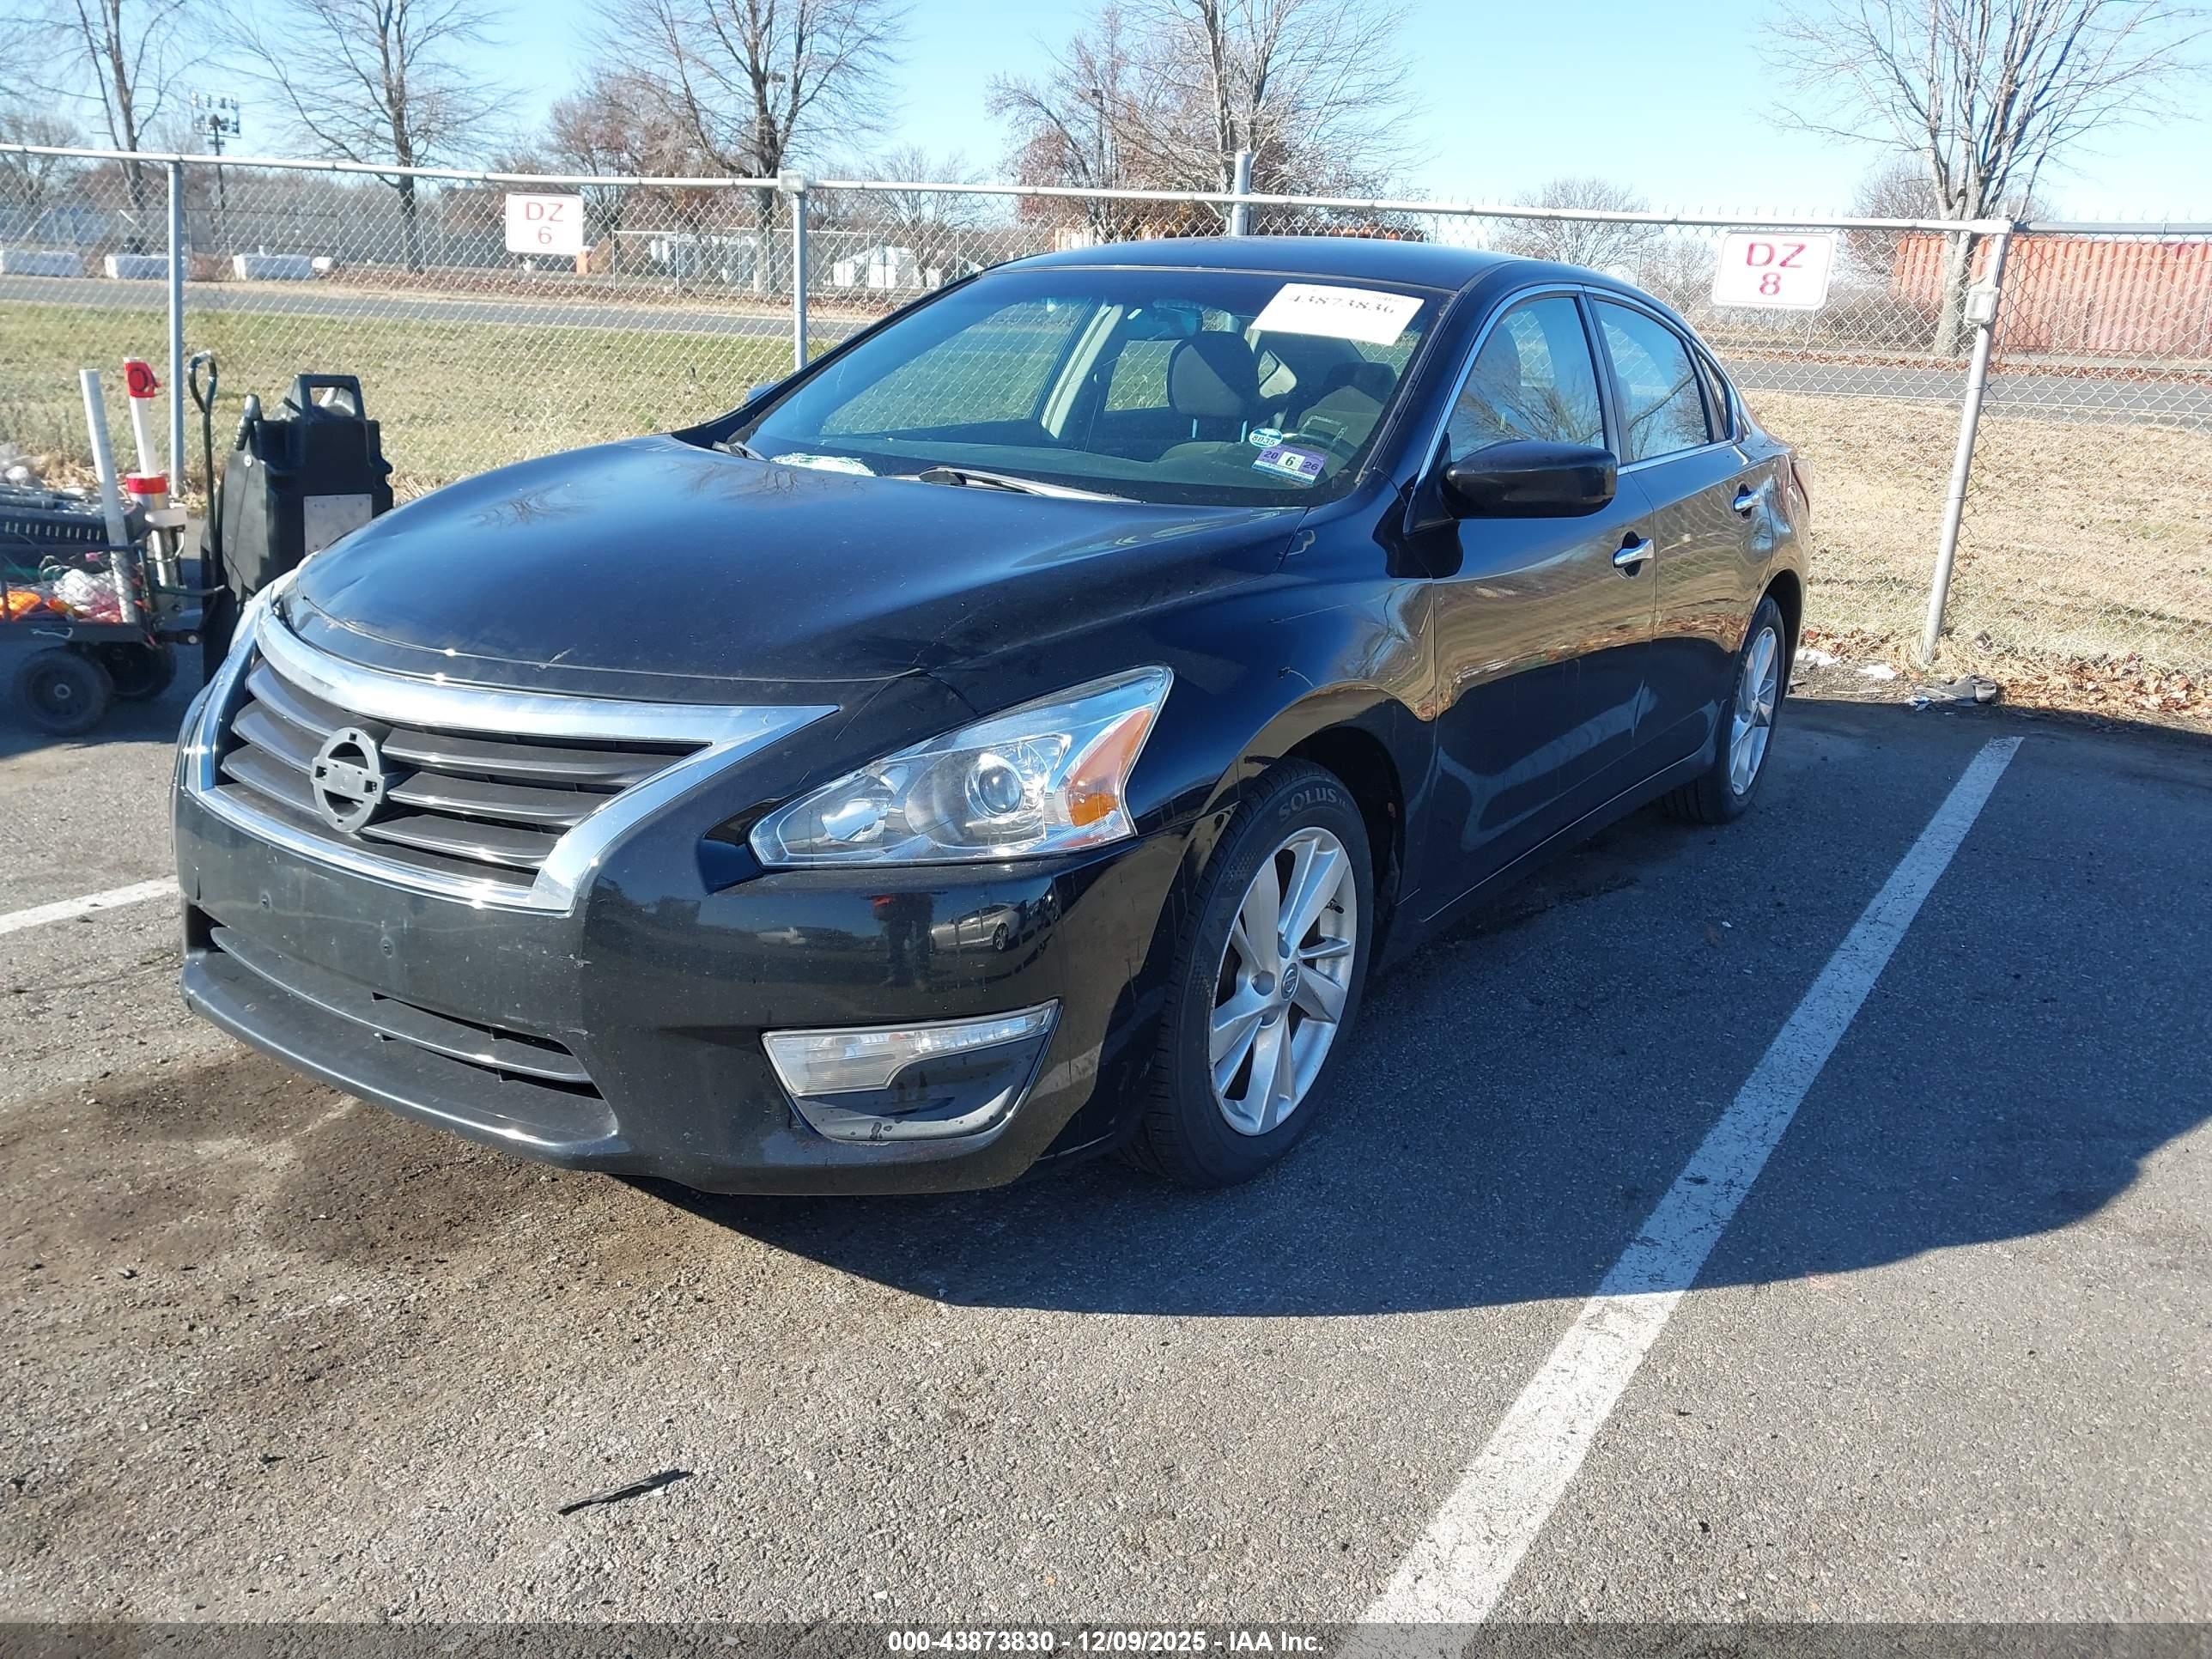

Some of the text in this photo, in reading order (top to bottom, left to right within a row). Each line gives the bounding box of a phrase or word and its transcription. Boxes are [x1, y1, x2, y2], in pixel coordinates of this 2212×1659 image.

[526, 201, 564, 222] DZ
[538, 226, 552, 245] 6
[1746, 242, 1807, 268] DZ
[1759, 272, 1781, 295] 8
[1263, 450, 1279, 460] 20
[1285, 455, 1296, 467] 6
[1303, 460, 1320, 471] 26
[1278, 787, 1338, 822] SOLUS
